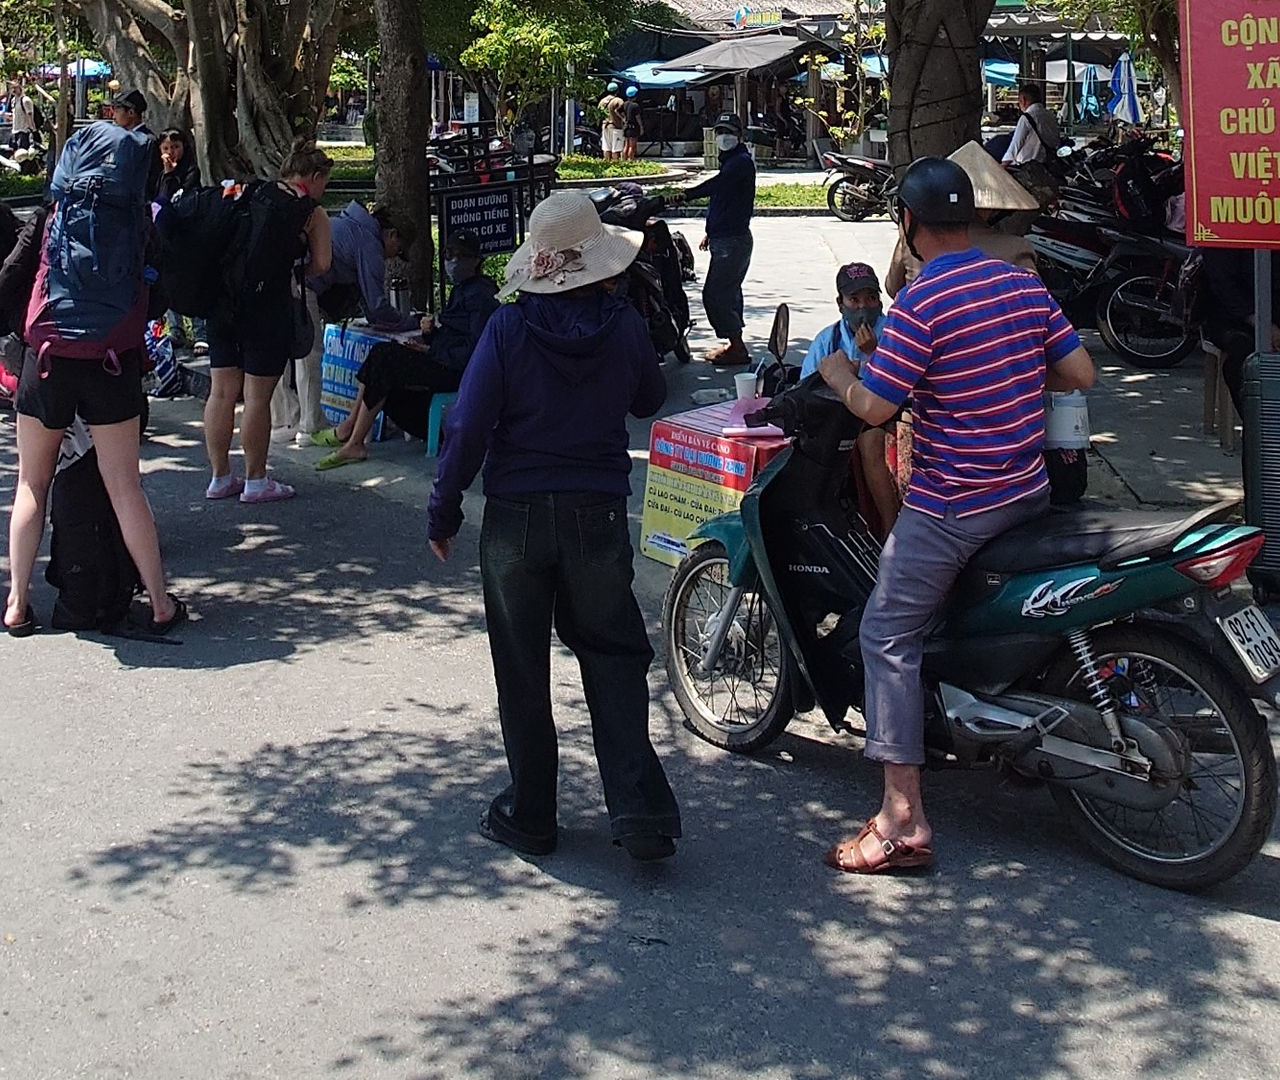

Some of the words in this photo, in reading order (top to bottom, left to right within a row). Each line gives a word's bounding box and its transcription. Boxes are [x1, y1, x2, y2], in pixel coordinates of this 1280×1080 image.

[1220, 98, 1275, 134] CHỦ
[451, 211, 481, 225] KHÔNG
[495, 223, 507, 233] XE
[657, 490, 668, 500] LAO
[683, 511, 695, 522] LAO
[788, 564, 830, 574] HONDA
[1228, 608, 1267, 645] 92-F1
